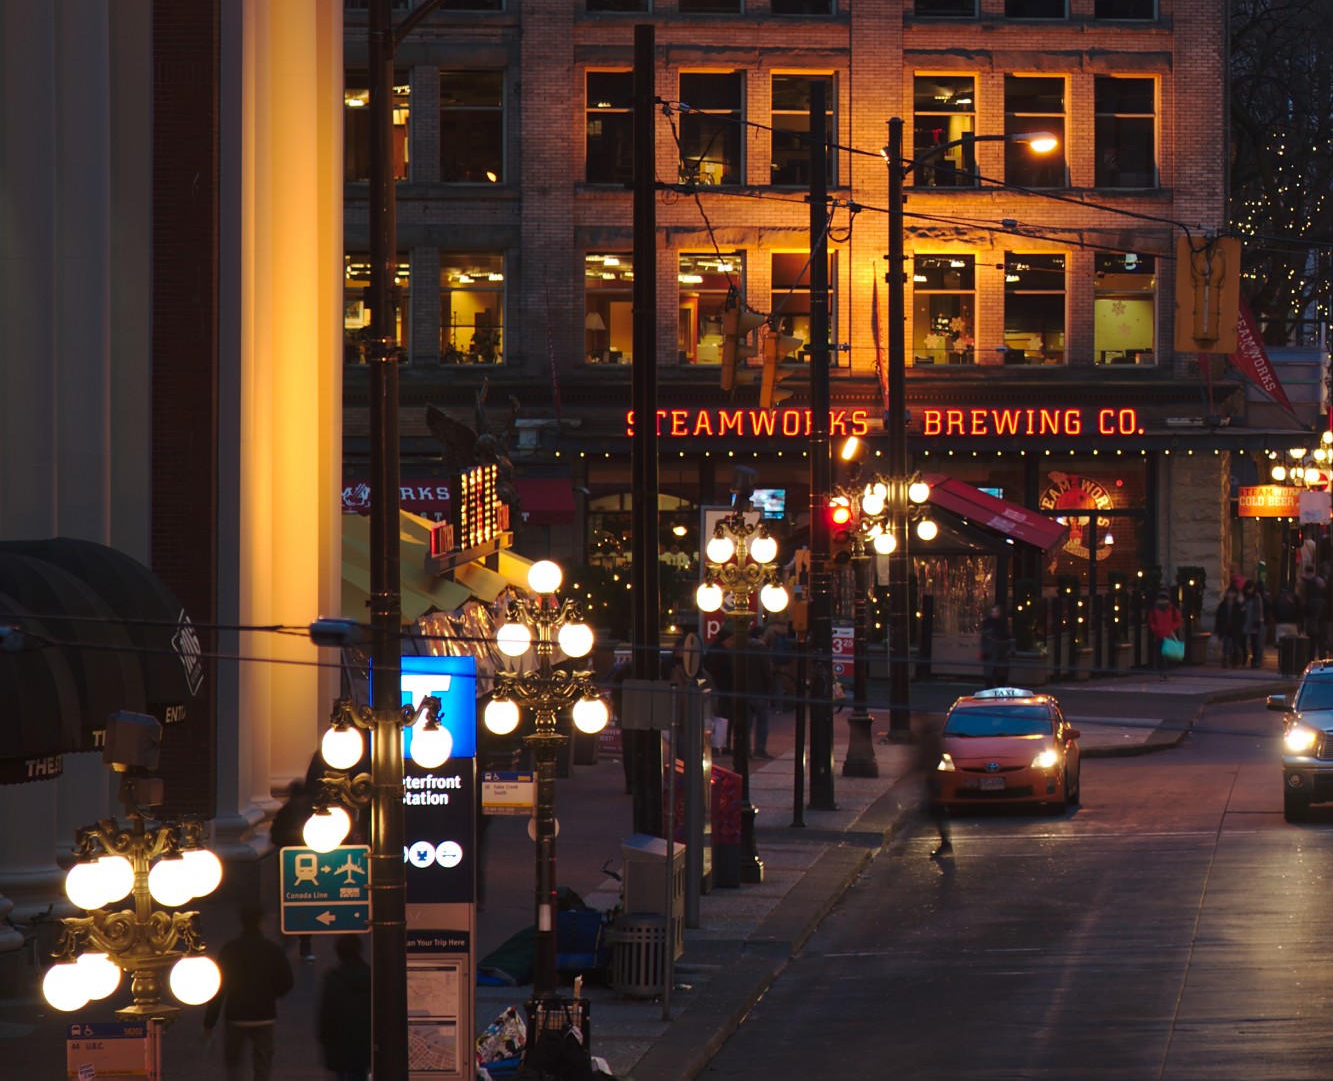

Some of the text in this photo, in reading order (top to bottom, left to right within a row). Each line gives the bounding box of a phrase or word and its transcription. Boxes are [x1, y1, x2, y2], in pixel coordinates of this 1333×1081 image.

[924, 409, 1083, 436] BREWING
[1100, 409, 1145, 436] CO.
[1240, 496, 1295, 507] COLD BEER
[994, 689, 1015, 697] TAXI
[403, 774, 462, 790] terfront
[403, 791, 450, 806] tation
[313, 891, 329, 899] Line
[416, 939, 432, 947] Your
[434, 939, 447, 949] Trip
[448, 939, 465, 947] Here
